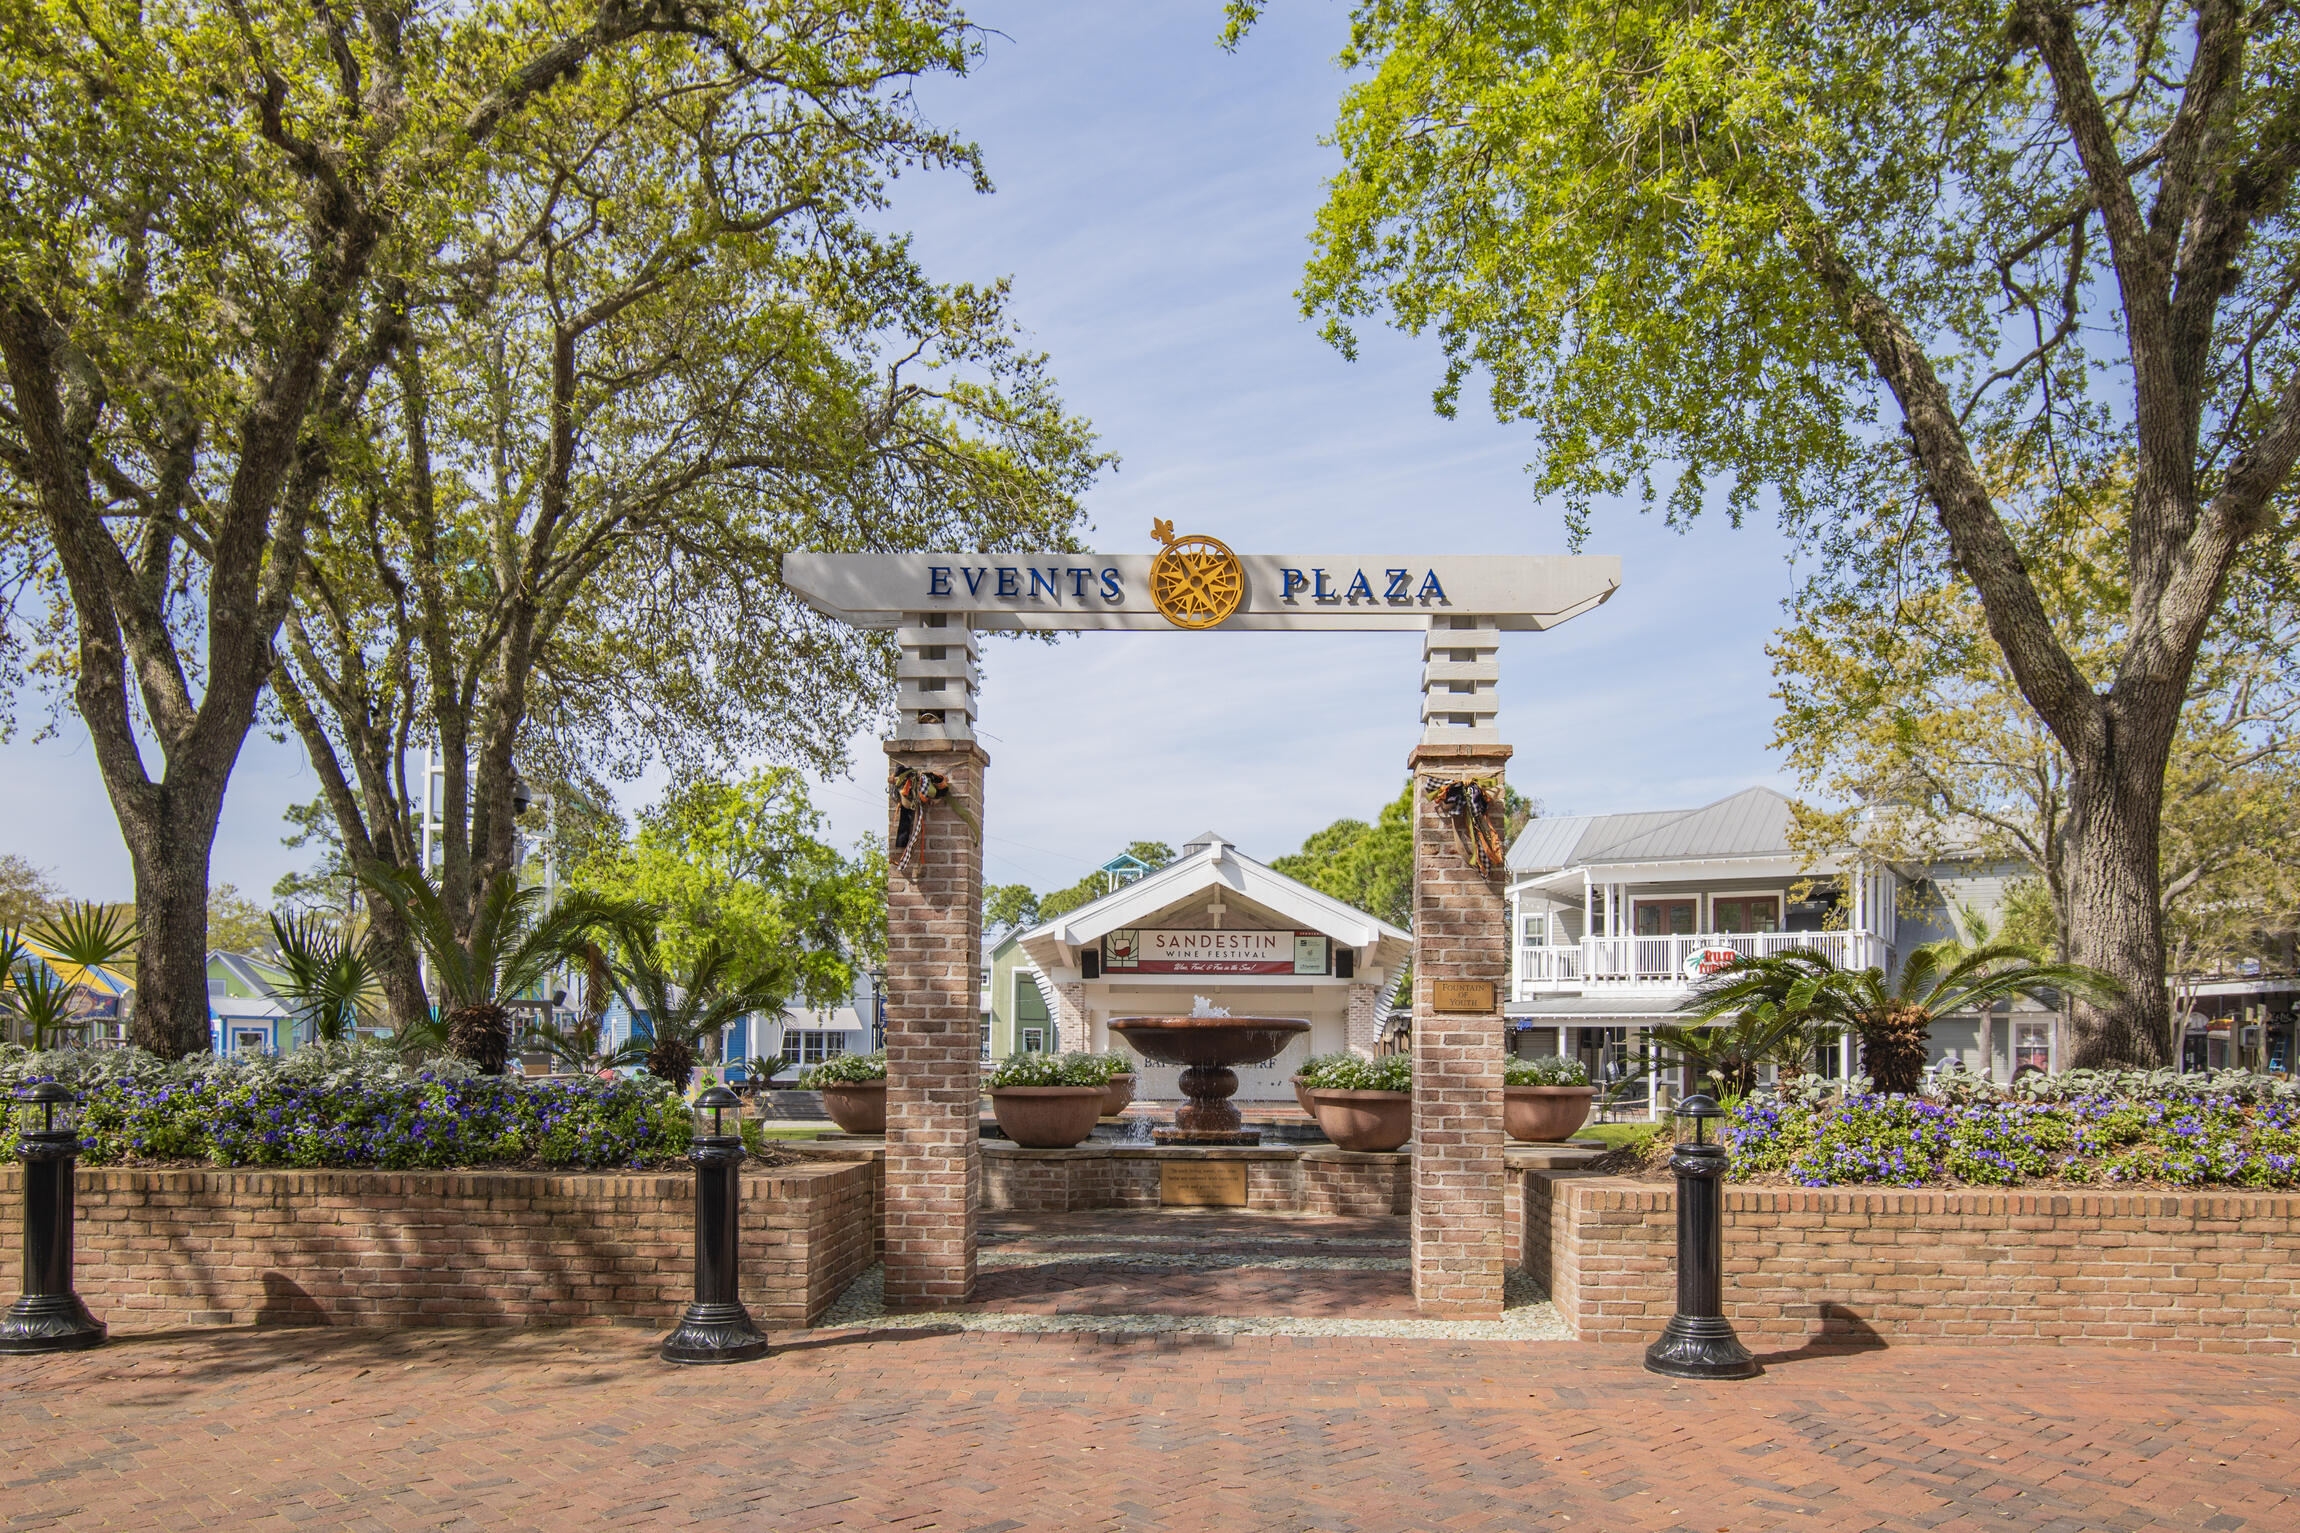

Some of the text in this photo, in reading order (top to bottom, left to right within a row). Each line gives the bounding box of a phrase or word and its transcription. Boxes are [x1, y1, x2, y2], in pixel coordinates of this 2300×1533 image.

[926, 566, 1448, 599] EVENTS PLAZA
[1156, 934, 1276, 949] SANDESTIN
[1165, 950, 1267, 959] WINE FESTIVAL
[1703, 950, 1736, 962] Rum
[1442, 983, 1485, 991] FOUNTAIN
[1449, 999, 1478, 1007] YOUTH
